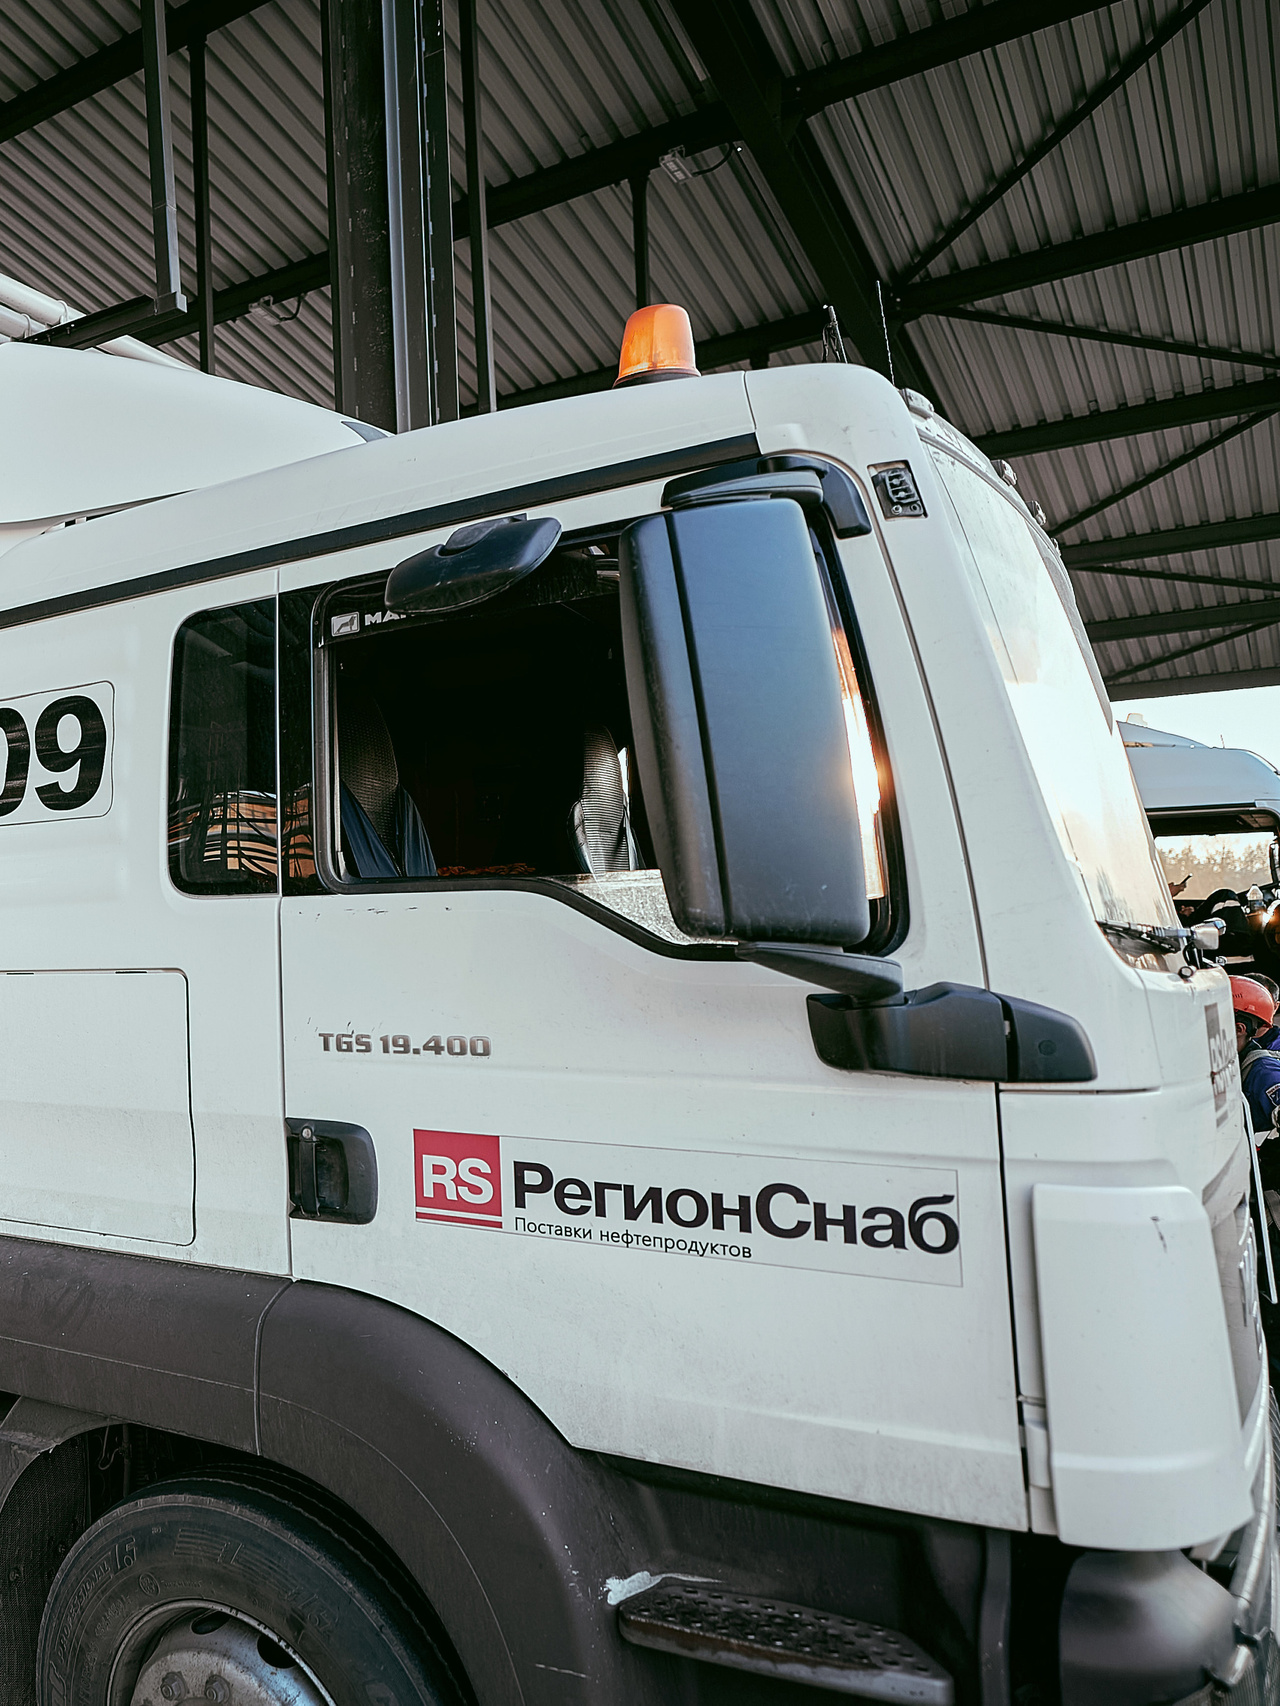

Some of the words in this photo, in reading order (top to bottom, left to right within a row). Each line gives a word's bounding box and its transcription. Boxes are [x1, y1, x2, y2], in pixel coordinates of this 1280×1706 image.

[365, 610, 415, 626] MA
[318, 1033, 372, 1053] TGS
[380, 1034, 491, 1057] 19.400
[421, 1154, 495, 1205] RS
[513, 1160, 959, 1255] РегионСнаб
[514, 1217, 593, 1240] Поставки
[599, 1229, 752, 1258] нефтепродуктов
